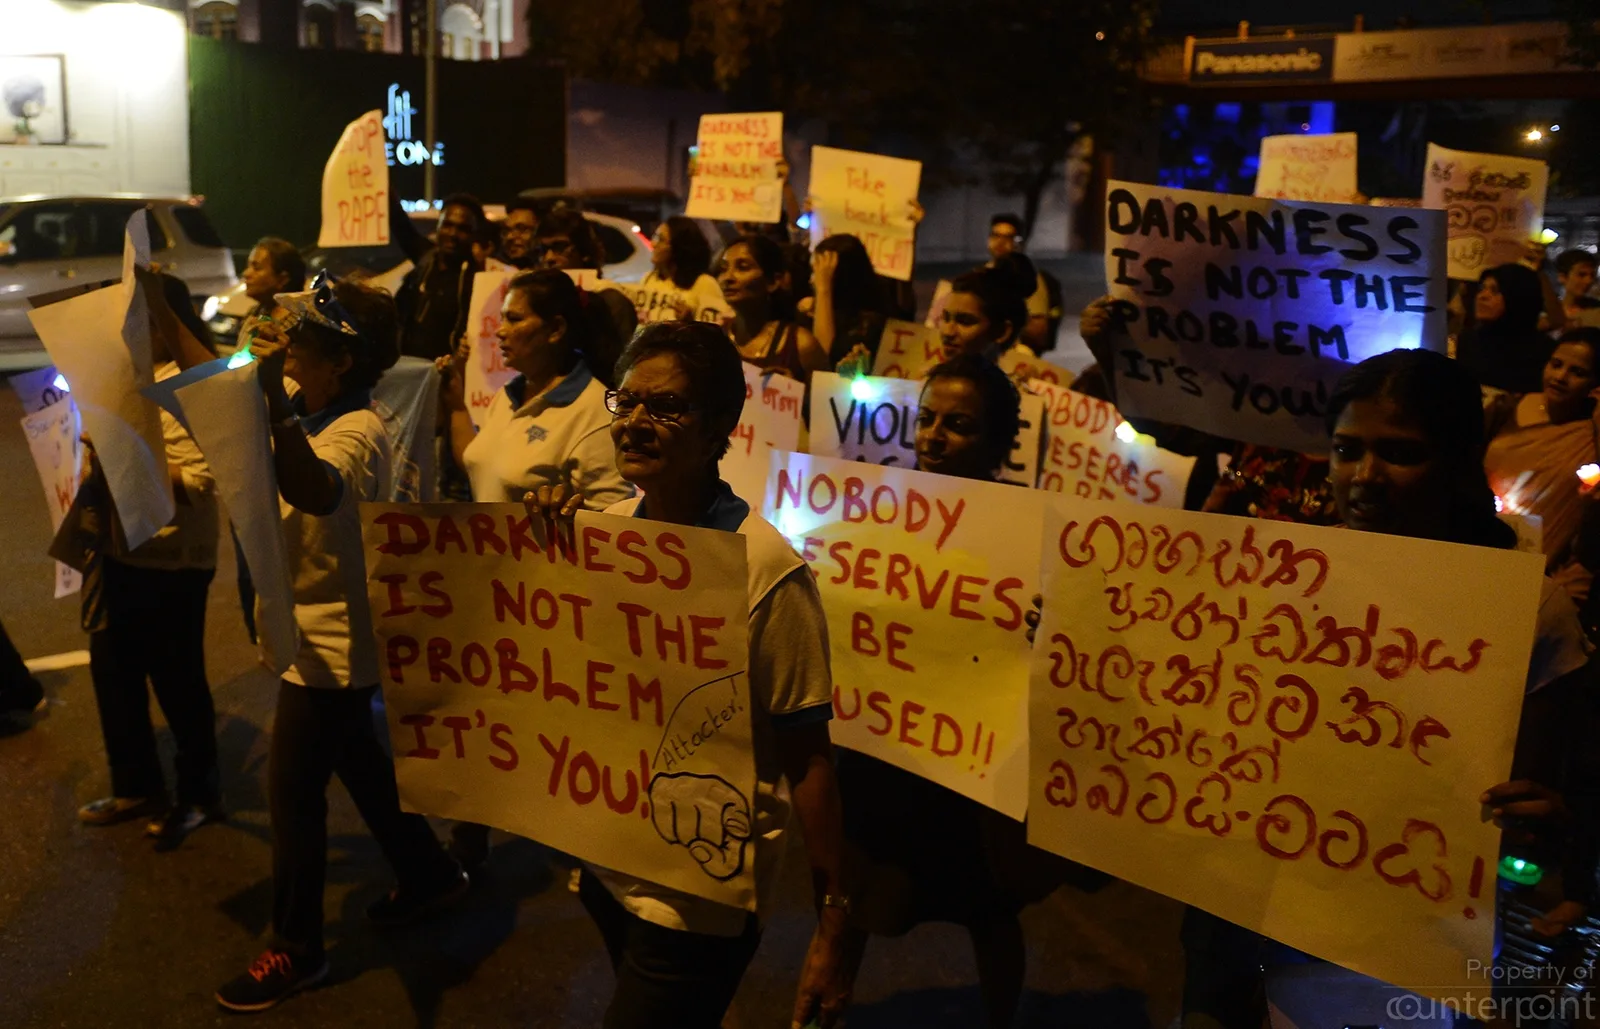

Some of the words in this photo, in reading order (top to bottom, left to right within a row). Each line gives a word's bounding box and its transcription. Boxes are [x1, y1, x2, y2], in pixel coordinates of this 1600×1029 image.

[1196, 47, 1322, 74] Panasonic
[338, 191, 387, 242] RAPE
[846, 166, 885, 198] Take
[1108, 188, 1422, 264] DARKNESS
[1112, 248, 1174, 296] IS
[1205, 262, 1309, 299] NOT
[1320, 269, 1436, 313] THE
[1109, 300, 1349, 360] PROBLEM
[1119, 350, 1202, 398] IT'S
[775, 469, 966, 554] NOBODY
[374, 512, 692, 590] DARKNESS
[783, 535, 1024, 631] ESERVES
[378, 571, 453, 618] IS
[491, 579, 592, 641] NOT
[617, 602, 730, 670] THE
[851, 612, 915, 673] BE
[387, 634, 664, 727] PROBLEM
[663, 676, 745, 772] Attacker!
[399, 709, 519, 772] IT'S
[538, 733, 651, 820] YOU!
